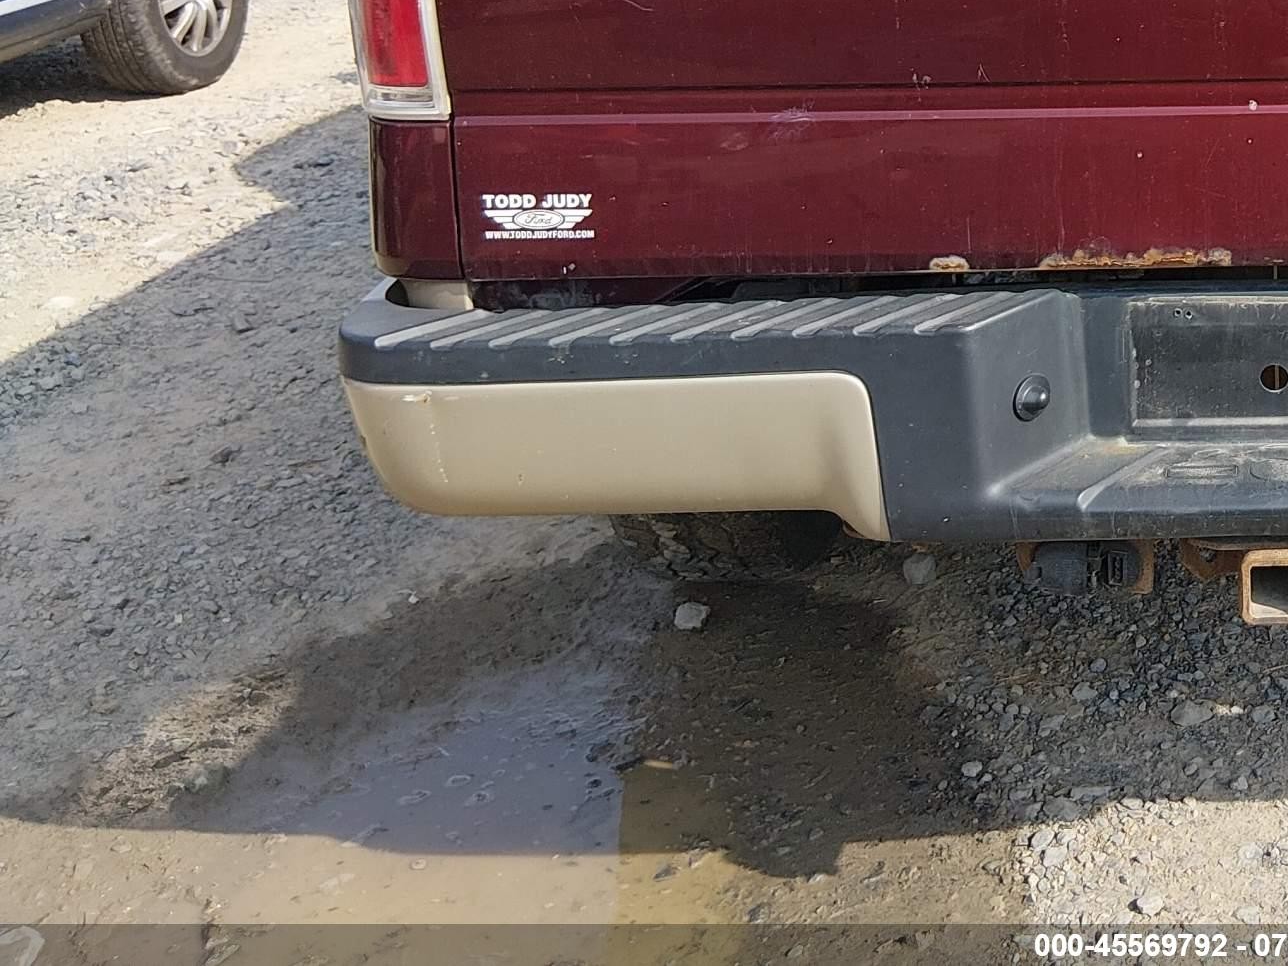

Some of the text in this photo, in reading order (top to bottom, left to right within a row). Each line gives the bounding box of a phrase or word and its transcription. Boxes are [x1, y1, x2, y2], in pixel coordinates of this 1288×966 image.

[482, 193, 593, 209] TODD JUDY
[484, 230, 595, 239] WWW.TODDJUDYFORD.COM
